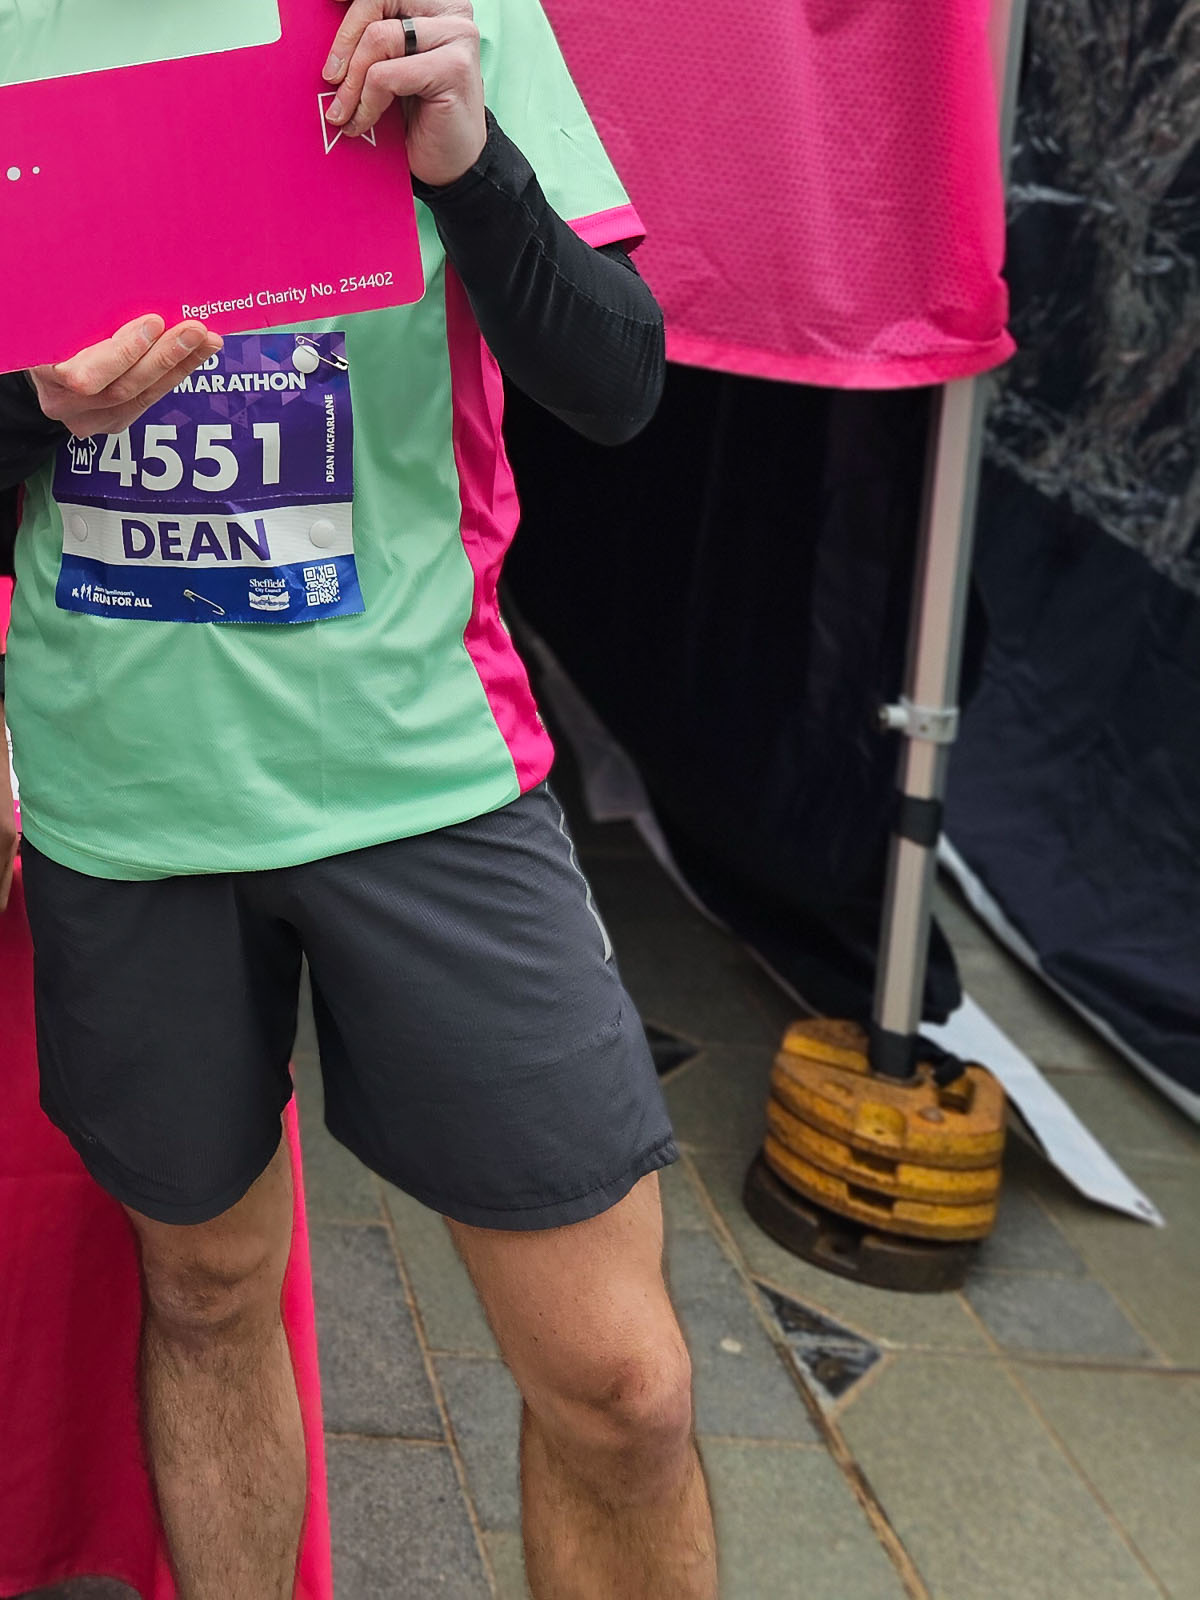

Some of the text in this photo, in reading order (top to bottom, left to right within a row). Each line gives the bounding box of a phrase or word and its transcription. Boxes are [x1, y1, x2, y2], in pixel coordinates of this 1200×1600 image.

[181, 271, 394, 320] Registered Charity No. 254402
[173, 371, 307, 394] MARATHON
[98, 422, 281, 493] 4551
[324, 394, 335, 483] DEAN MCFARLANE
[120, 518, 272, 562] DEAN
[92, 592, 153, 608] RUN FOR ALL
[249, 578, 286, 588] Sheffield
